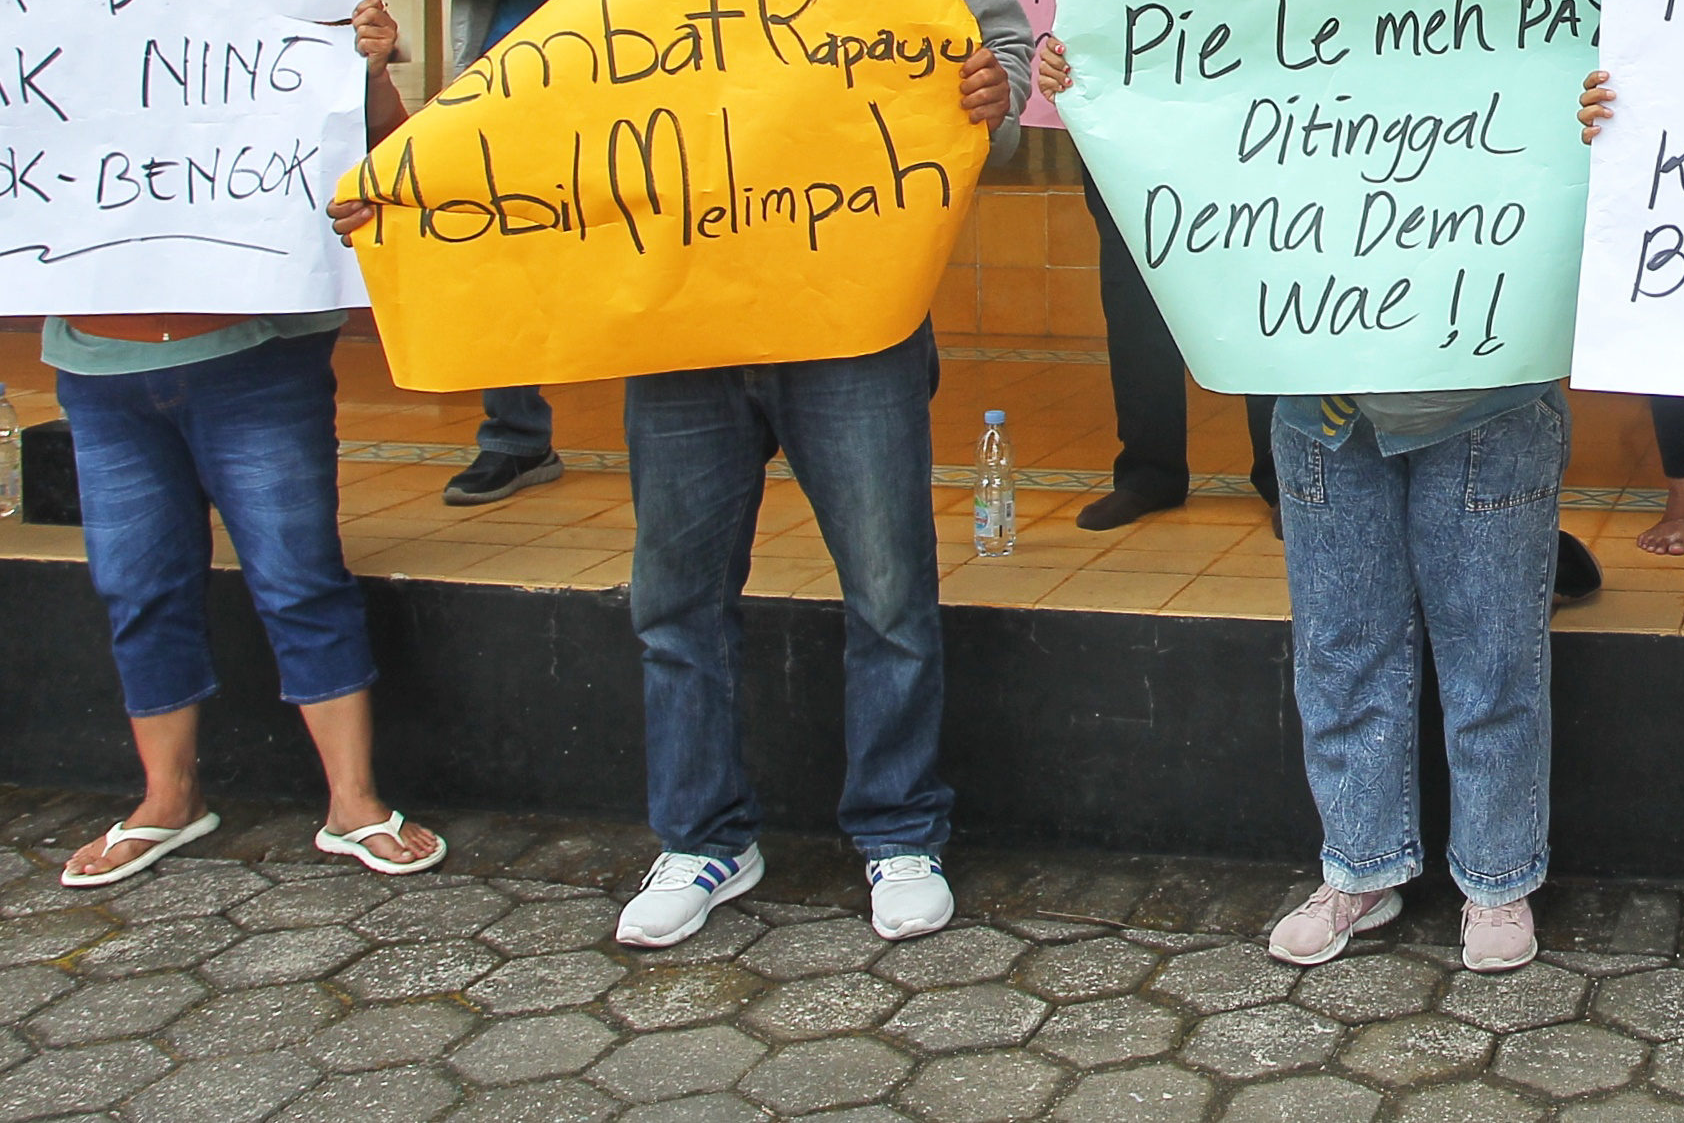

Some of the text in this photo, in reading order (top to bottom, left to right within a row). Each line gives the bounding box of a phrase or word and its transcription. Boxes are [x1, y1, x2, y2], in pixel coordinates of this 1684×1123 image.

[142, 36, 333, 107] NING
[1124, 3, 1241, 85] Pie
[359, 101, 950, 255] Mobil Melimpah
[1145, 185, 1525, 268] Dema Demo
